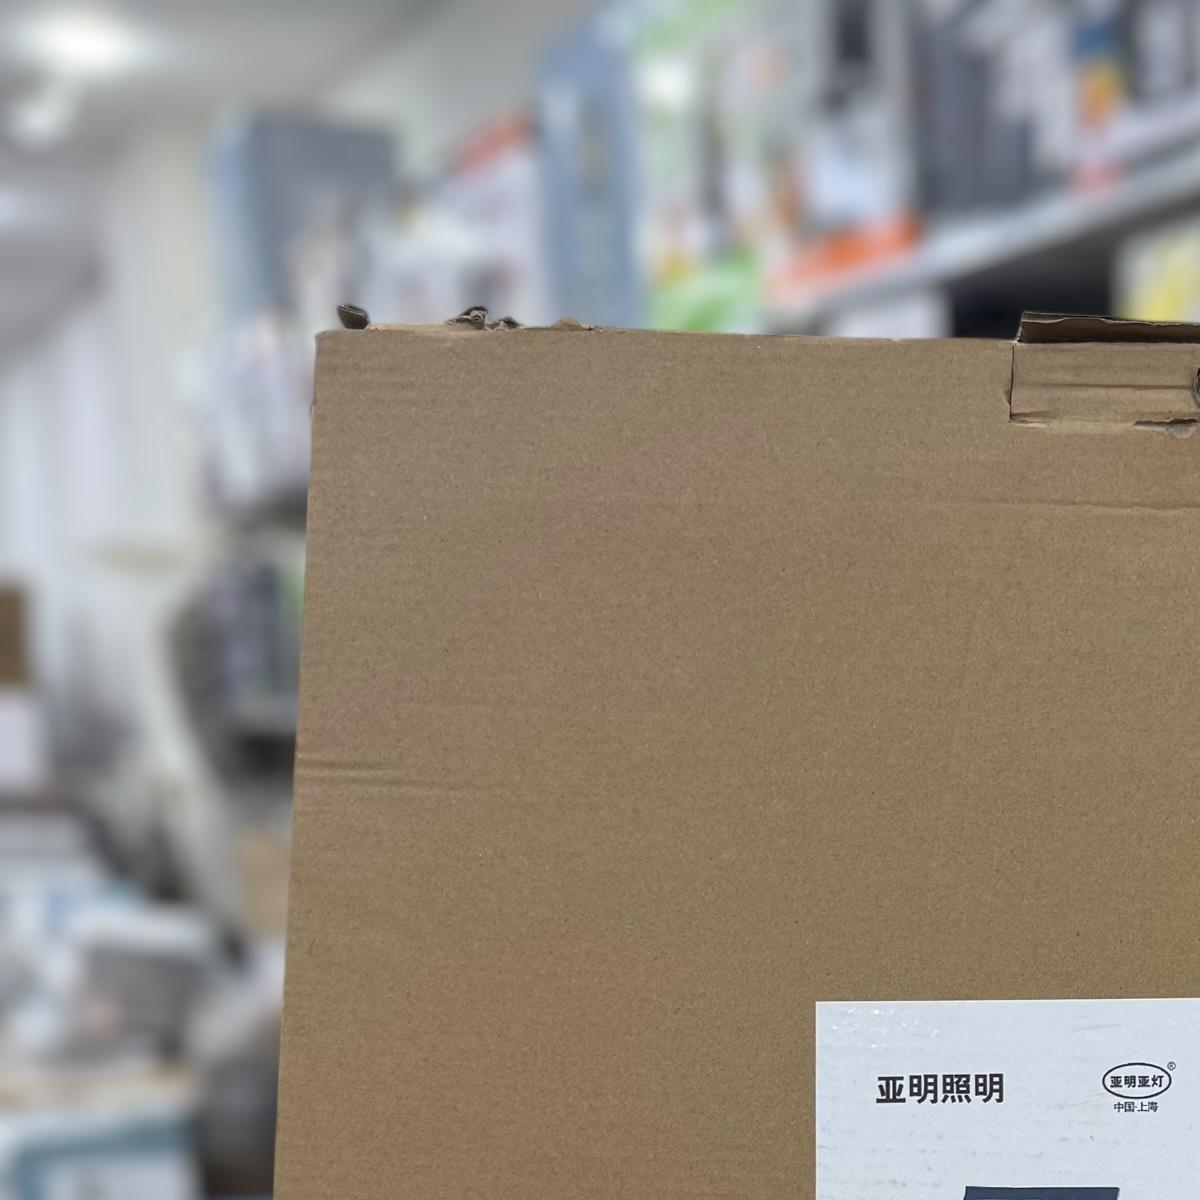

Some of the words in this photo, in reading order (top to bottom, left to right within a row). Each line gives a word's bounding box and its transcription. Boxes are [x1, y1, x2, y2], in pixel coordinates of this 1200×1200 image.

[1110, 1075, 1164, 1088] 亚明亚灯
[876, 1073, 1004, 1105] 亚明照明
[1113, 1101, 1158, 1113] 中国·上海
